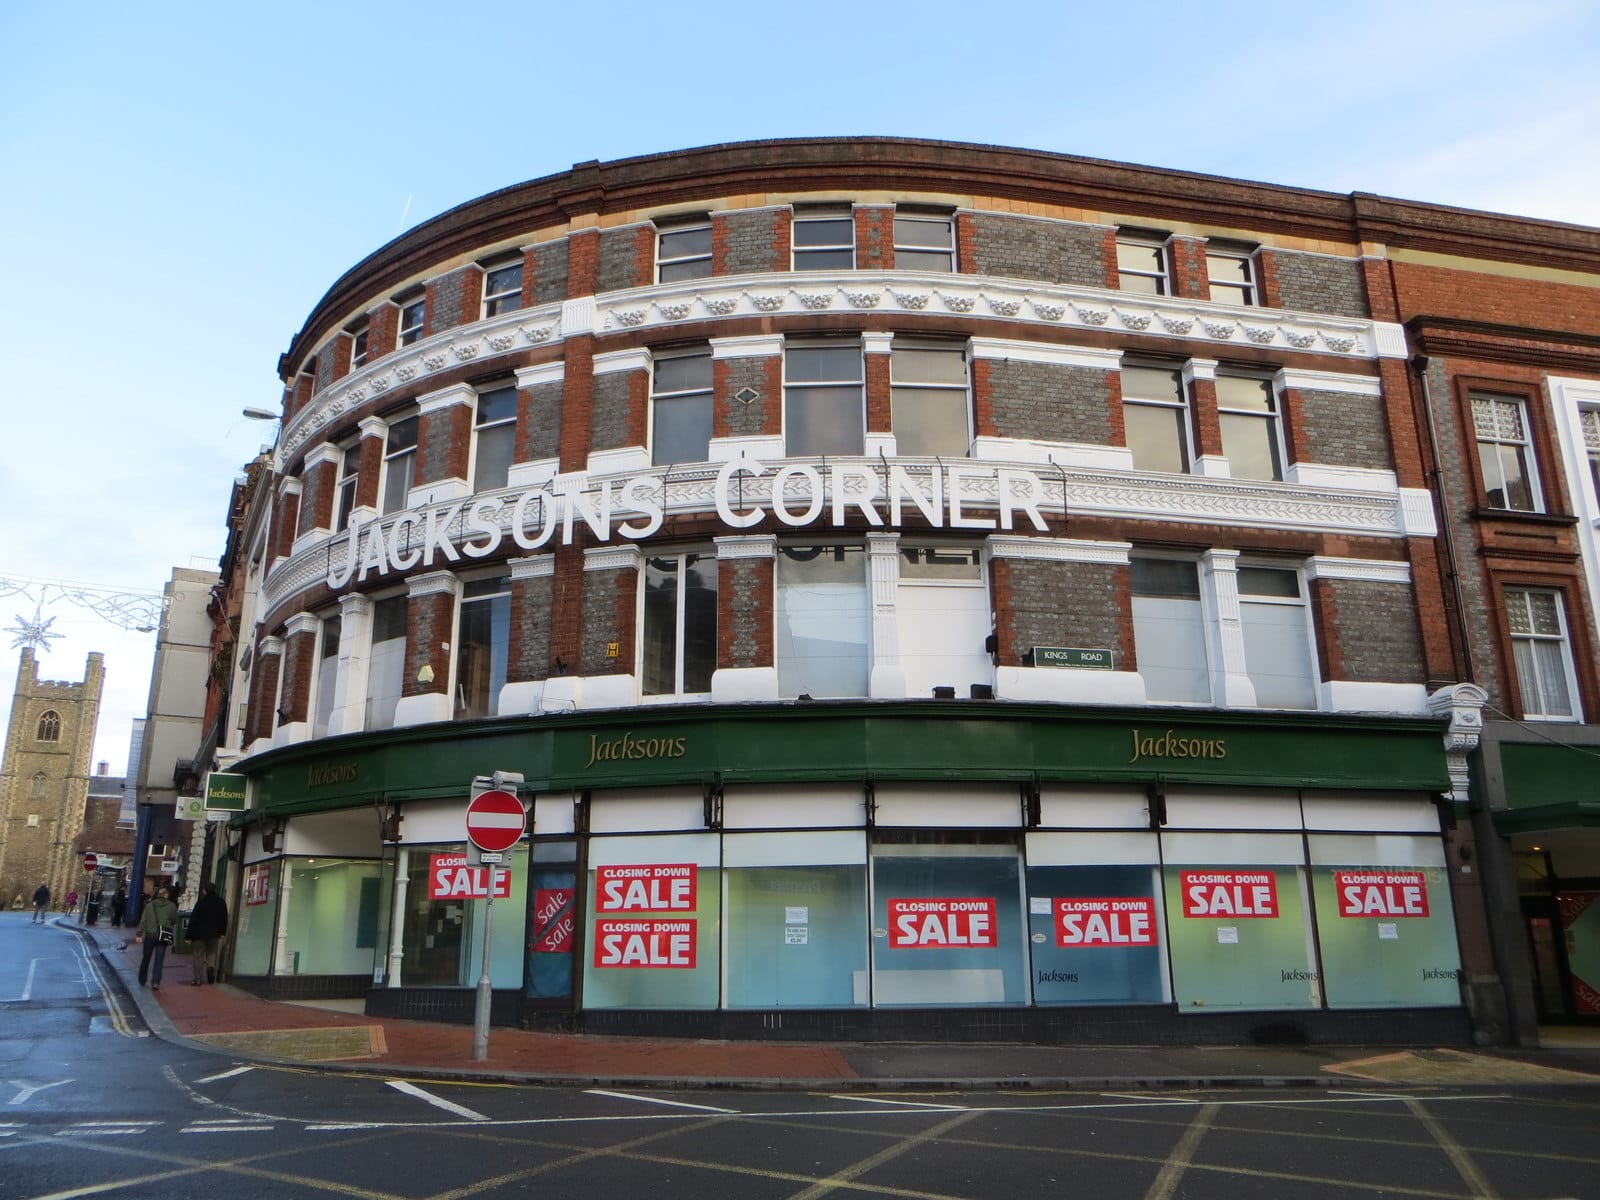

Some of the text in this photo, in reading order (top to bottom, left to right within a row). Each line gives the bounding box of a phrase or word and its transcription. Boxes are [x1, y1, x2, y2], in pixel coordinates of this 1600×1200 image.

[326, 458, 1049, 589] JACKSONS CORNER
[1044, 651, 1103, 662] KINGS ROAD
[585, 732, 686, 768] Jacksons
[1130, 729, 1226, 764] Jacksons
[307, 762, 359, 791] Jacksons
[208, 787, 246, 800] Jacksons
[435, 869, 506, 897] SALE
[603, 867, 691, 878] CLOSING DOWN
[1187, 874, 1269, 884] CLOSING DOWN
[1341, 875, 1419, 884] CLOSING DOWN
[537, 890, 567, 926] Sale
[603, 879, 690, 909] SALE
[895, 901, 988, 912] CLOSING DOWN
[1061, 902, 1109, 911] CLOSING
[1112, 902, 1147, 911] DOWN
[1189, 886, 1272, 915] SALE
[1344, 886, 1423, 914] SALE
[545, 917, 575, 952] Sale
[603, 922, 690, 933] CLOSING DOWN
[897, 914, 990, 945] SALE
[1063, 913, 1150, 943] SALE
[601, 935, 690, 965] SALE
[1038, 969, 1079, 984] Jacksons
[1281, 968, 1319, 983] Jacksons
[1423, 968, 1459, 981] Jacksons
